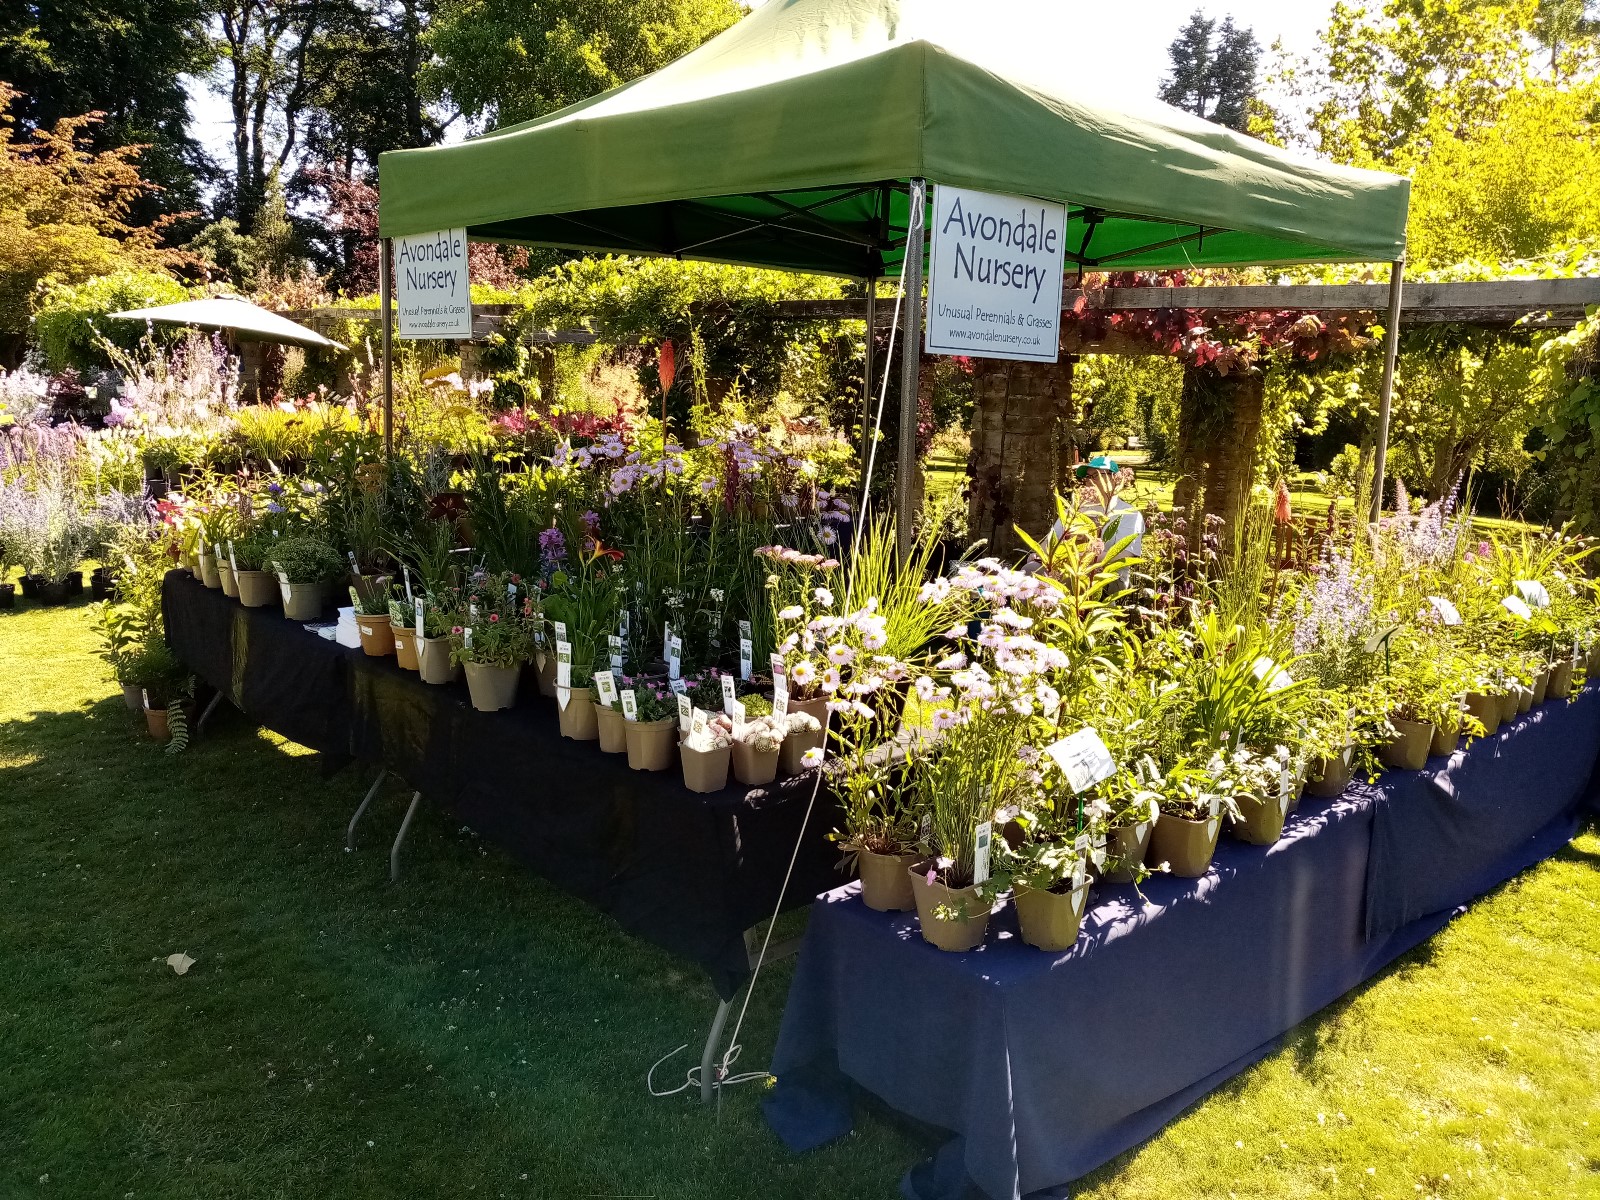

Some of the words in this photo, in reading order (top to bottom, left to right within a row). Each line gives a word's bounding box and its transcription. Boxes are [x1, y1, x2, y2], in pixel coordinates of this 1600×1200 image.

[943, 196, 1057, 254] Avondale
[400, 228, 461, 264] Avondale
[406, 266, 457, 297] Nursery
[954, 242, 1046, 304] Nursery
[938, 303, 974, 321] Unusual
[975, 306, 1016, 326] Perennials
[1017, 313, 1025, 327] &
[1026, 313, 1053, 329] Grasses
[949, 328, 1041, 347] www.avondalenursery.co.uk
